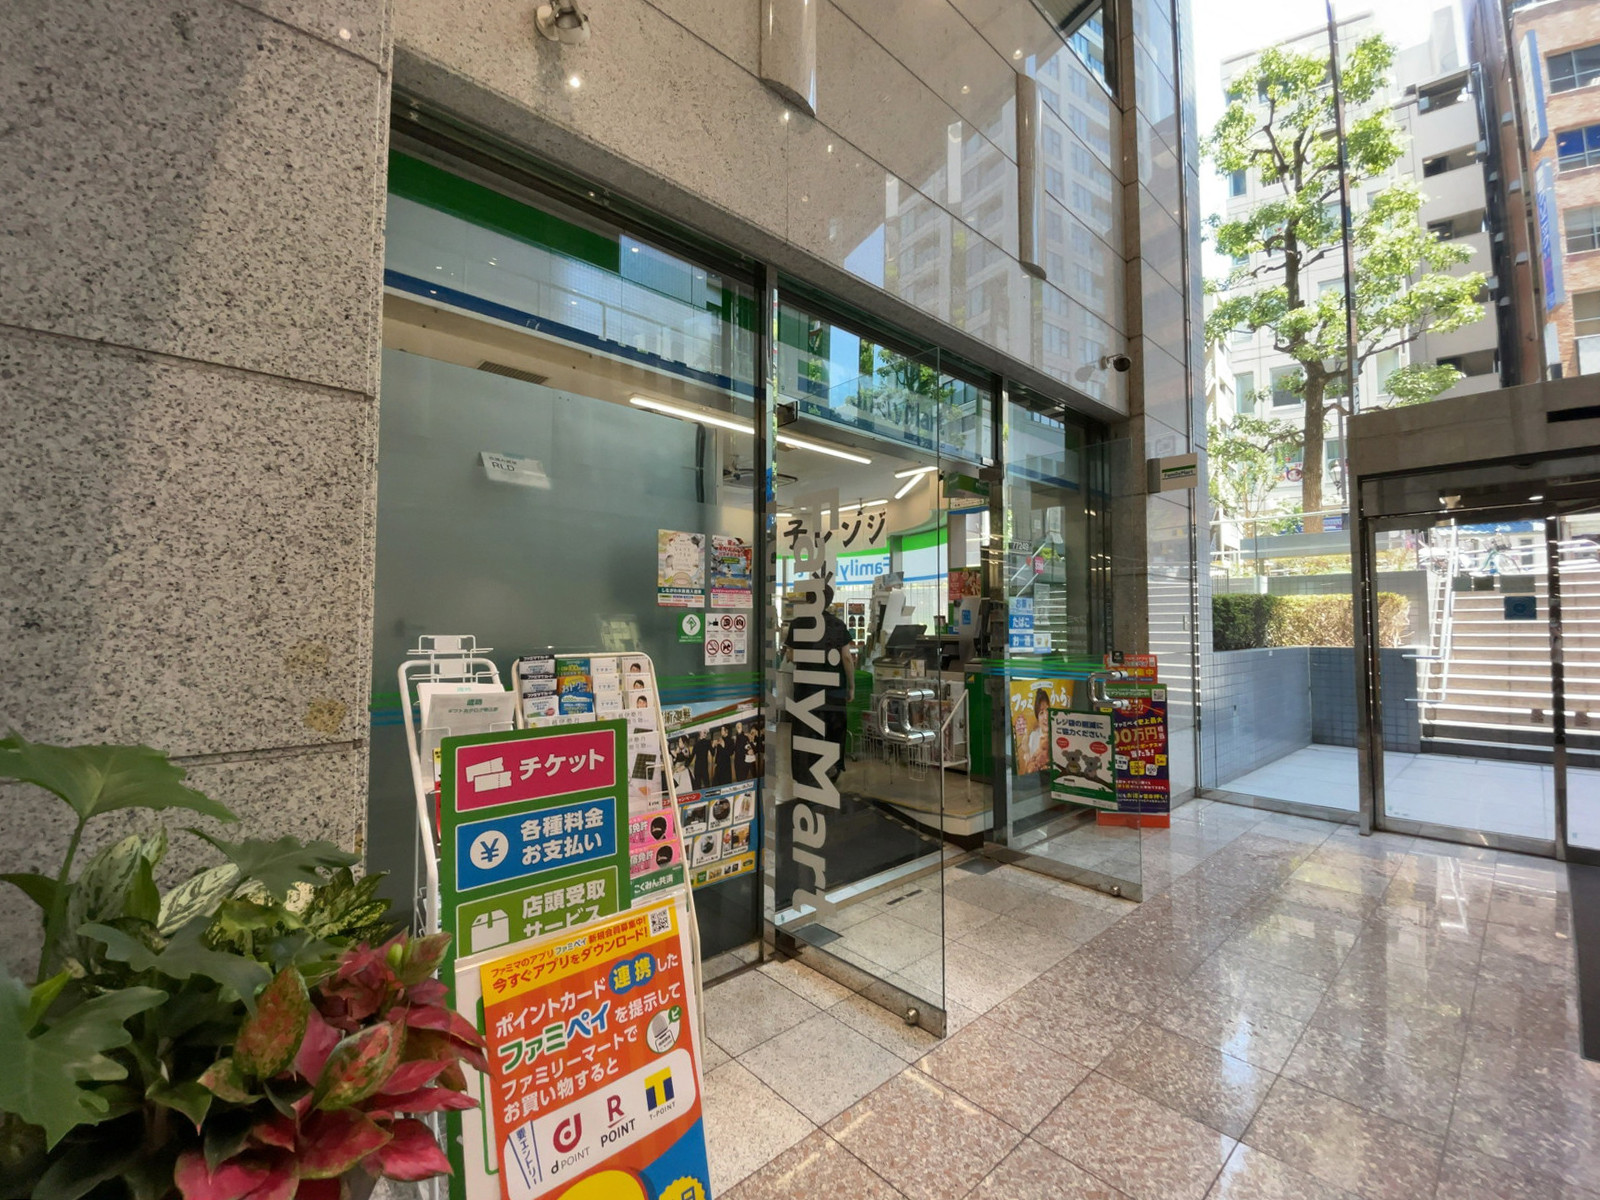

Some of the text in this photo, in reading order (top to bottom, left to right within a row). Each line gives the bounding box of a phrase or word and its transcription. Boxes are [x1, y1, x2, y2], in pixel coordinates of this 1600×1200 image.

[786, 488, 840, 917] FamilyMart
[519, 749, 605, 781] チケット
[520, 807, 604, 842] 各種料金
[521, 833, 602, 866] お支払い
[521, 878, 606, 920] 店頭受取
[523, 904, 601, 939] サービス
[492, 926, 649, 994] 今すぐアプリをダウンロード!
[501, 1025, 638, 1101] ファミリーマートで
[503, 1056, 620, 1124] お買い物すると
[600, 1118, 636, 1148] POINT
